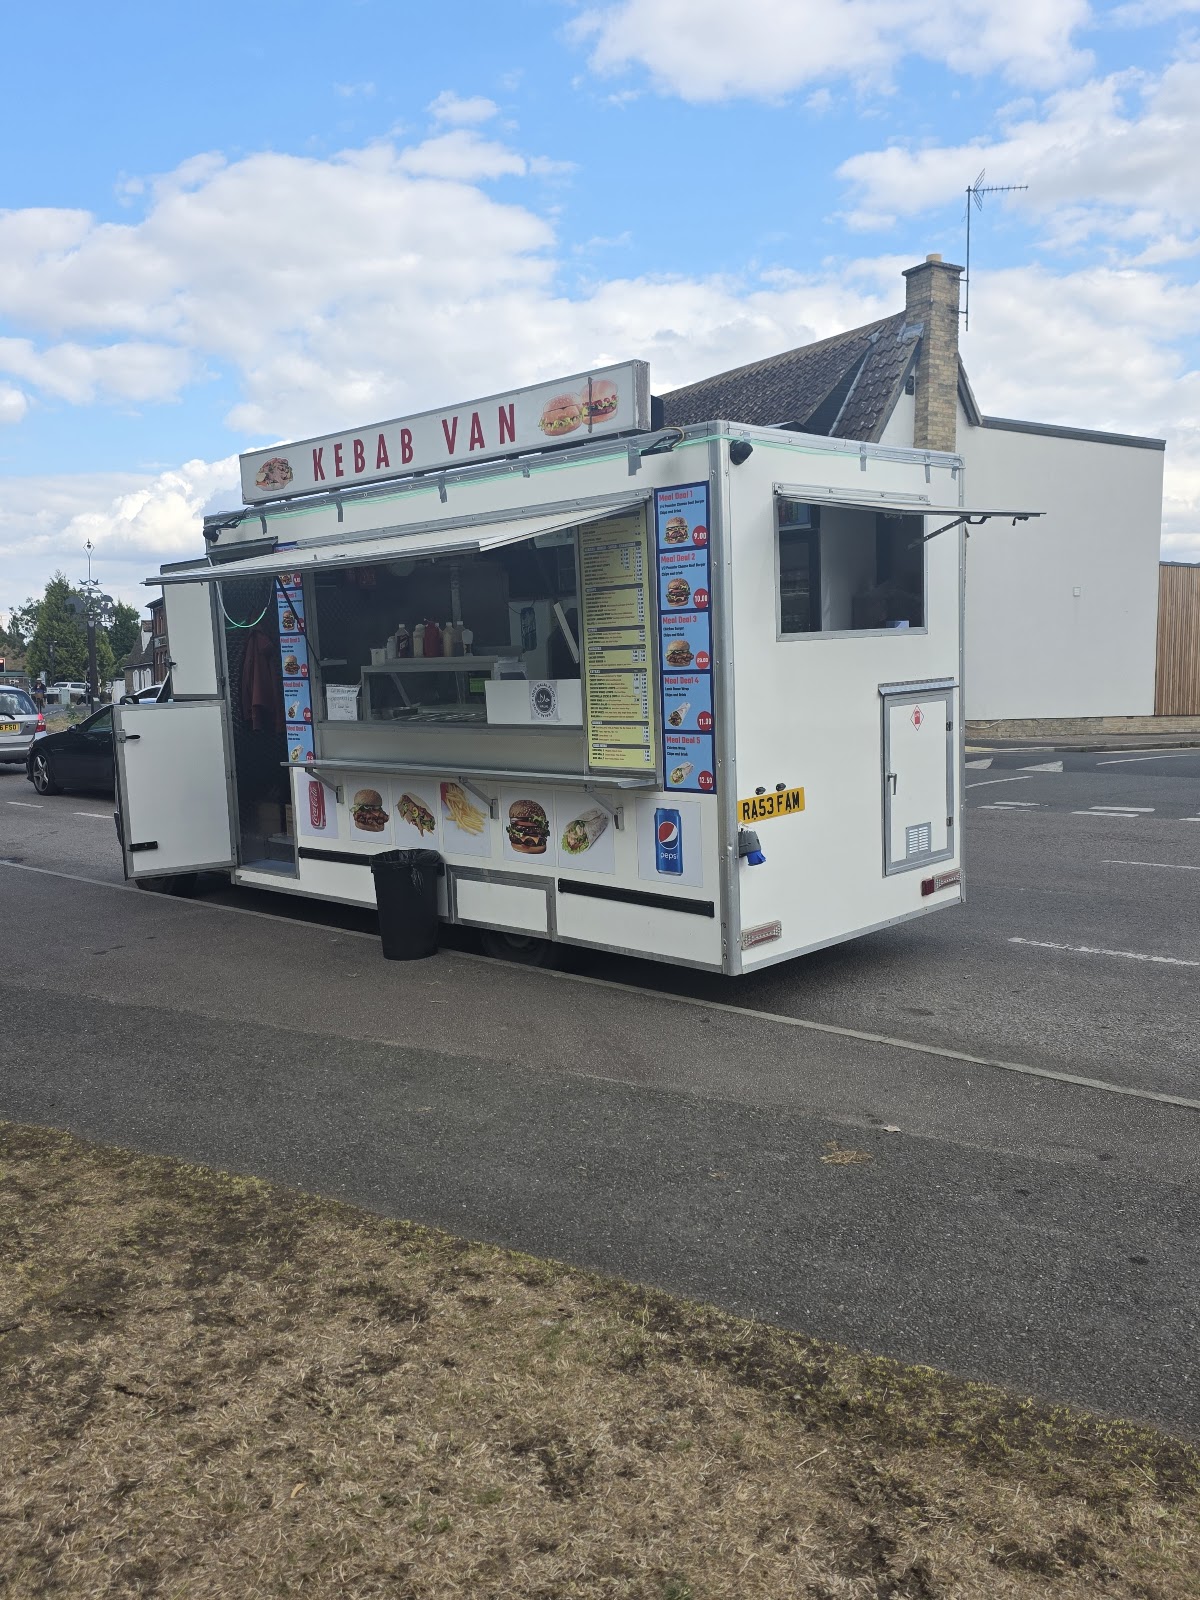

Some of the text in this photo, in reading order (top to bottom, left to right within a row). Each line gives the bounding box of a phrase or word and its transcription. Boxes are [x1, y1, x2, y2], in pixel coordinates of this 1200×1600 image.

[312, 403, 516, 481] KEBAB VAN
[658, 490, 693, 502] Meal Deal 1
[661, 552, 695, 563] Meal Deal 2
[663, 616, 677, 624] Meal
[678, 615, 691, 623] Deal
[680, 676, 693, 684] Deal
[667, 736, 700, 744] Meal Deal 5
[742, 791, 800, 820] RA53 FAM
[660, 851, 679, 861] pepsi
